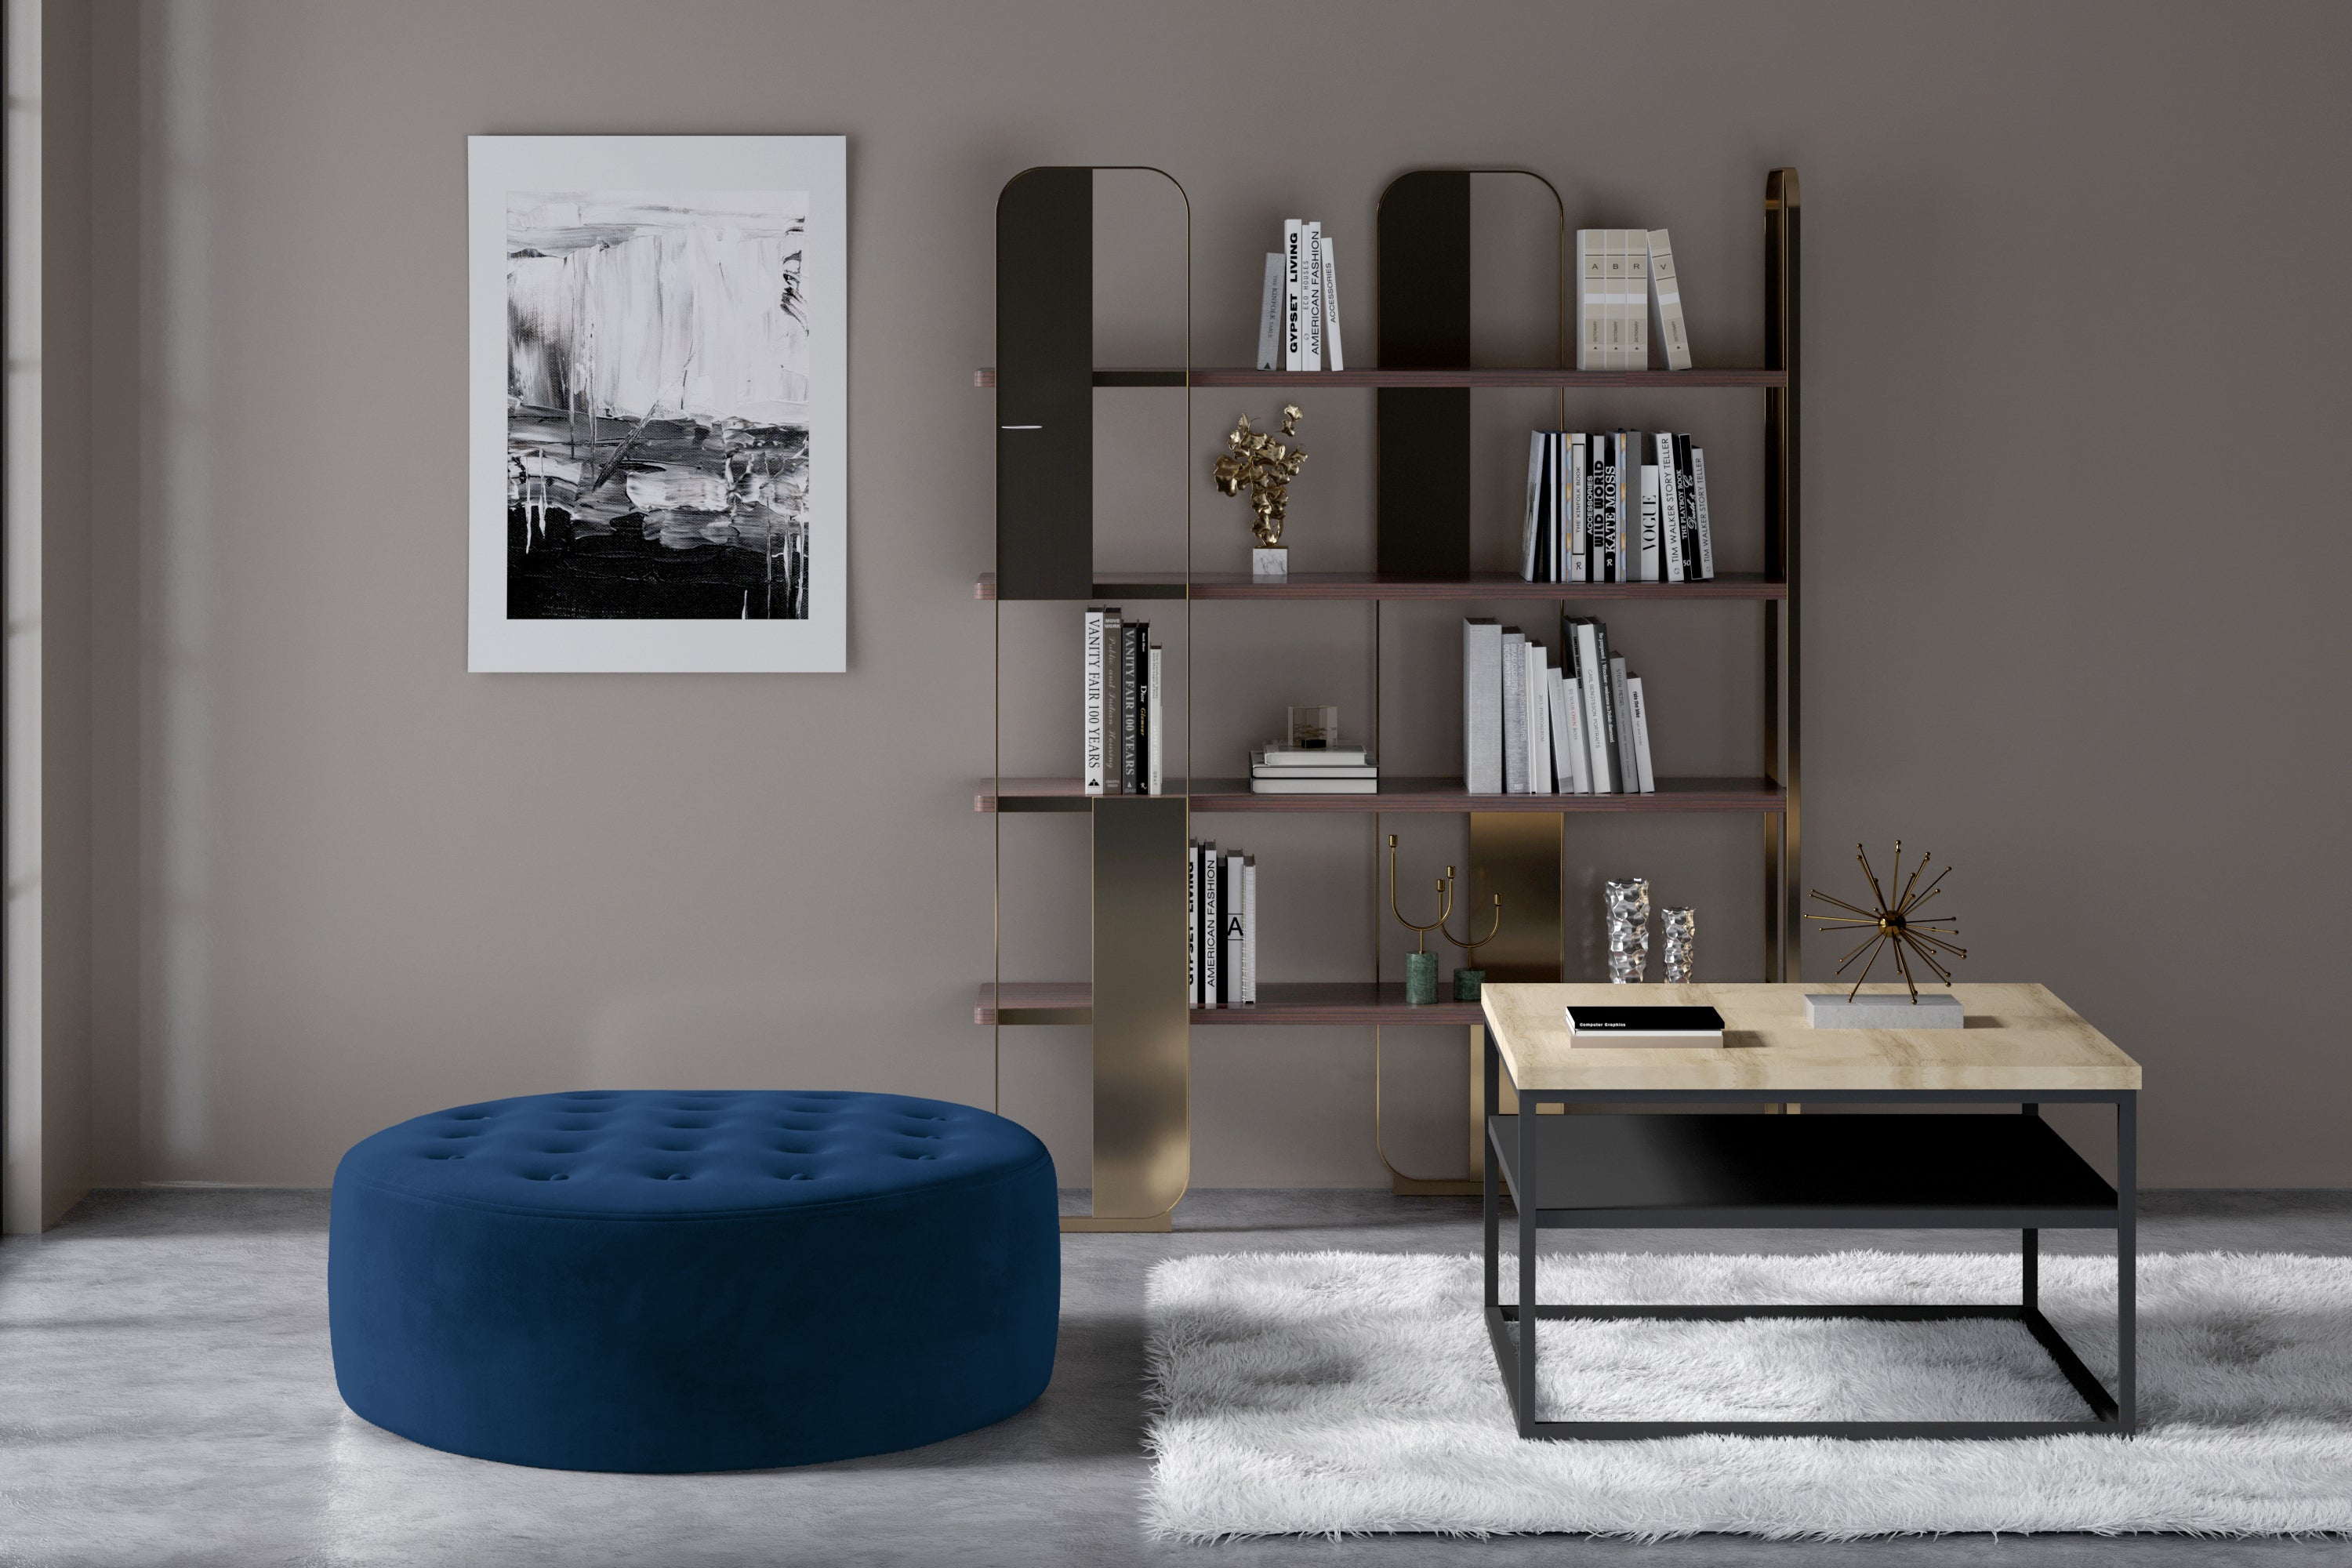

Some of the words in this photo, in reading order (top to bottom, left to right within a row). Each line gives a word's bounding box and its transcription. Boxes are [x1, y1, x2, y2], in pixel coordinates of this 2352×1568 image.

[1290, 233, 1298, 283] LIVING
[1311, 231, 1319, 285] FASHION
[1326, 263, 1336, 323] ACCESSORIES
[1290, 293, 1298, 354] GYPSET
[1311, 289, 1319, 355] AMERICAN
[1661, 438, 1671, 470] TELLER
[1595, 460, 1604, 510] WORLD
[1605, 465, 1616, 509] MOSS
[1664, 472, 1673, 503] STORY
[1697, 485, 1705, 512] STORY
[1642, 495, 1657, 552] VOGUE
[1666, 506, 1677, 543] WALKER
[1678, 490, 1686, 524] PLAYBOY
[1687, 499, 1697, 530] Death
[1595, 514, 1604, 548] WILD
[1605, 512, 1616, 554] KATE
[1700, 513, 1708, 546] WALKER
[1088, 619, 1100, 668] VANITY
[1108, 636, 1116, 666] Public
[1125, 630, 1135, 677] VANITY
[1088, 673, 1100, 701] FAIR
[1125, 681, 1135, 710] FAIR
[1588, 684, 1597, 717] BENGTSSON
[1088, 706, 1100, 724] 100
[1108, 691, 1116, 725] Indian
[1125, 713, 1135, 731] 100
[1088, 727, 1100, 768] YEARS
[1592, 718, 1601, 749] PORTRAITS
[1125, 735, 1135, 775] YEARS
[1207, 860, 1215, 915] FASHION
[1227, 916, 1243, 936] A
[1207, 920, 1215, 987] AMERICAN
